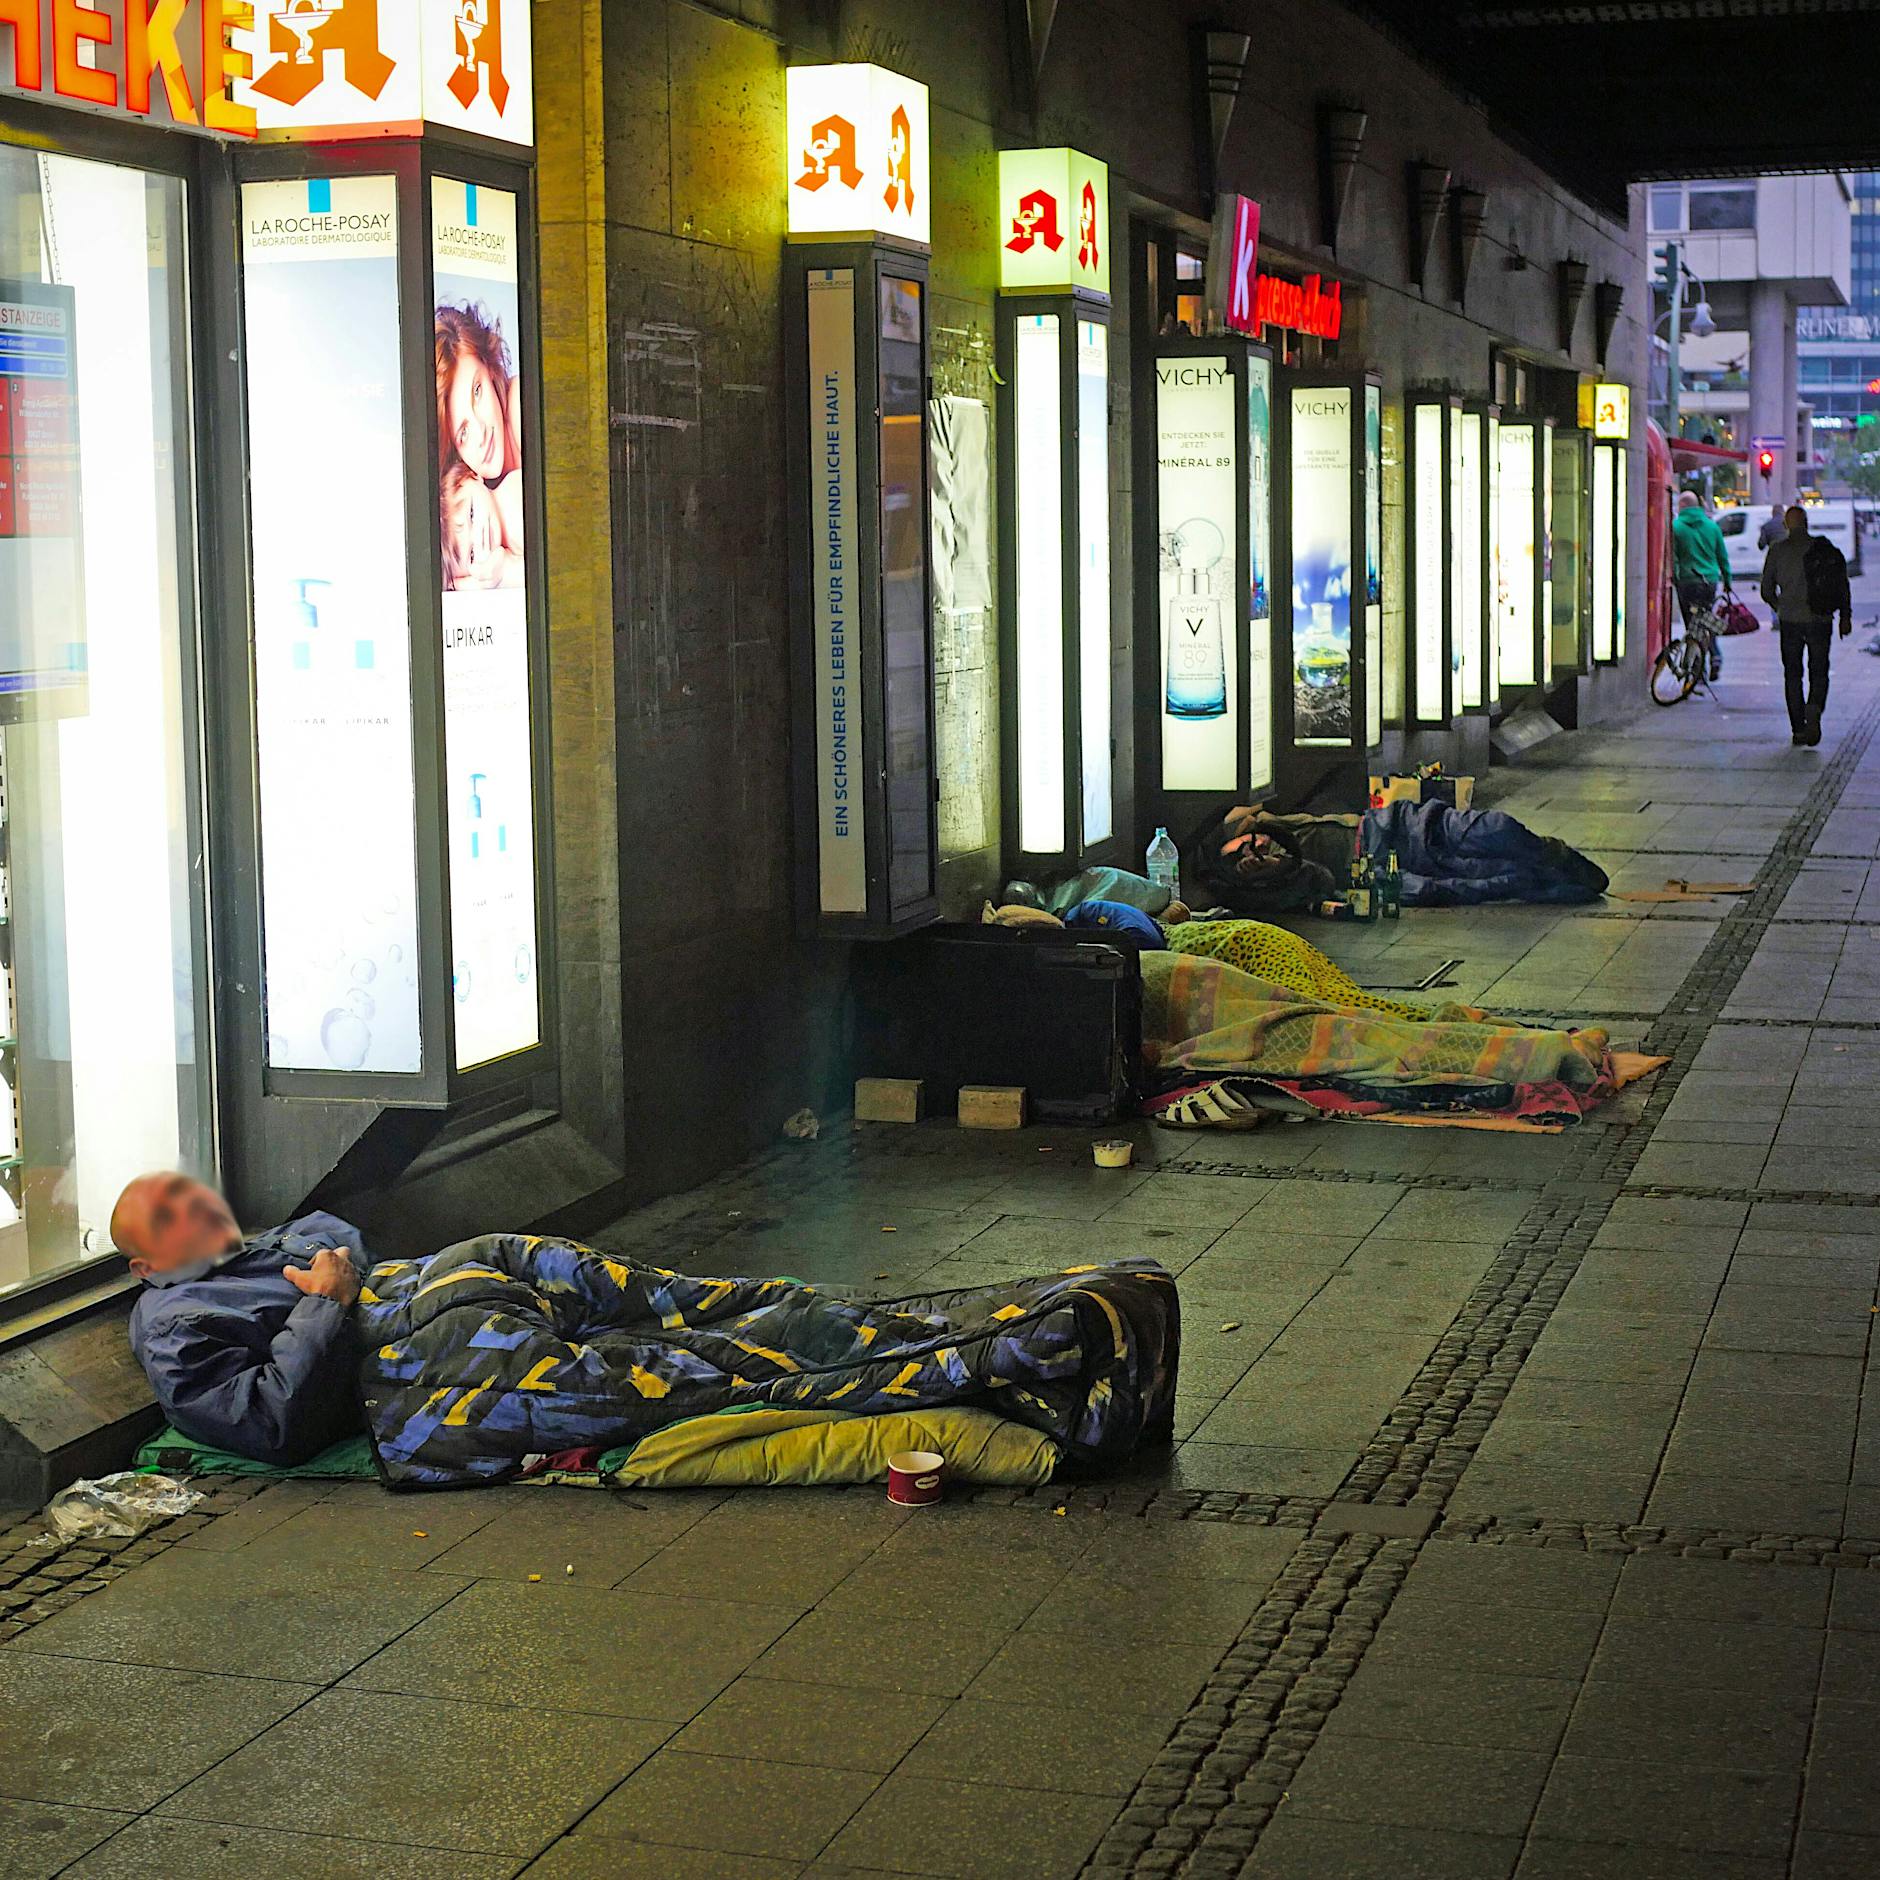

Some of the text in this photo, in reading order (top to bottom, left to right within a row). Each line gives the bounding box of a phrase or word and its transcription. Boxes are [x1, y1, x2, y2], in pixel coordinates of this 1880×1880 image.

[252, 213, 391, 235] LA ROCHE-POSAY
[252, 232, 392, 248] LABORATOIRE DERMATOLOGIQUE
[1156, 368, 1228, 386] VICHY
[1295, 402, 1349, 415] VICHY
[1161, 431, 1225, 440] ENTDECKEN SIE
[1215, 457, 1231, 467] 89
[825, 369, 849, 837] EIN SCHÖNERES LEBEN FÜR EMPFINDLICHE HAUT.
[445, 626, 494, 648] LIPIKAR
